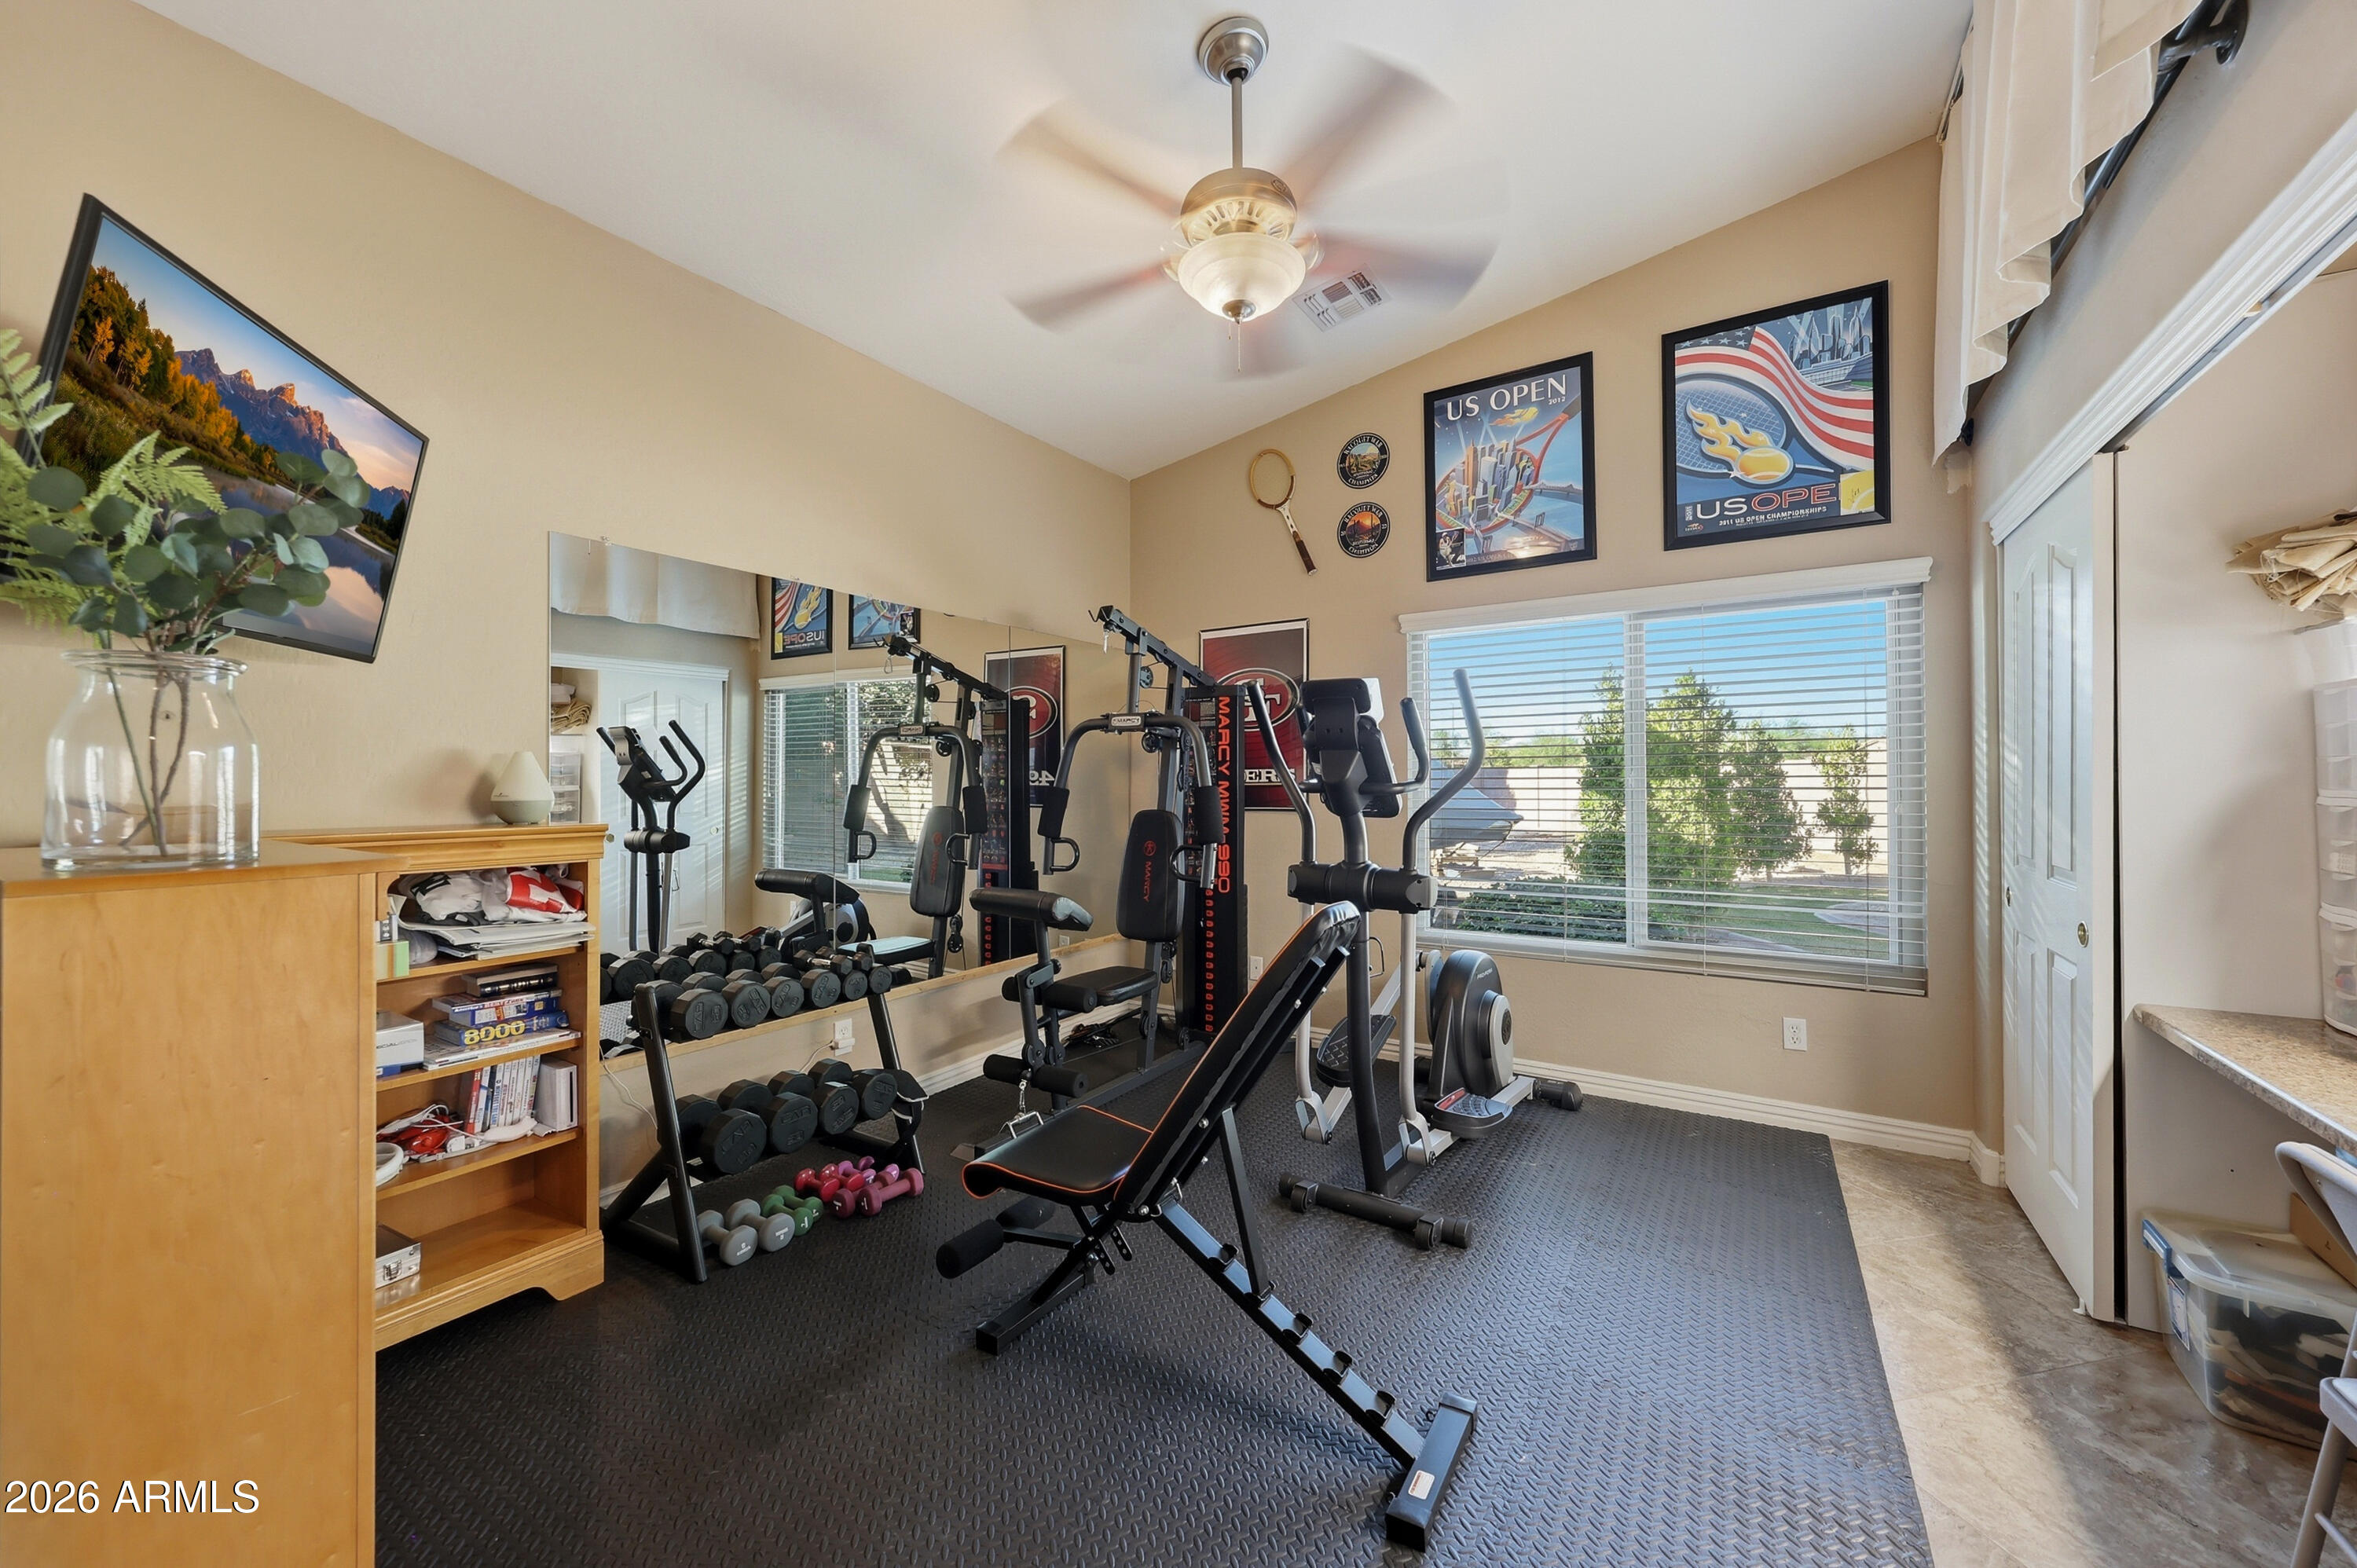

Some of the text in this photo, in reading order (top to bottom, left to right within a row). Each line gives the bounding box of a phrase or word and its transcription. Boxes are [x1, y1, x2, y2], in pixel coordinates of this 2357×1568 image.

[1446, 374, 1567, 421] US OPEN
[1548, 396, 1566, 405] 2012
[1218, 696, 1230, 775] MARCY
[1143, 861, 1152, 903] MARCY
[464, 1020, 526, 1046] 8000
